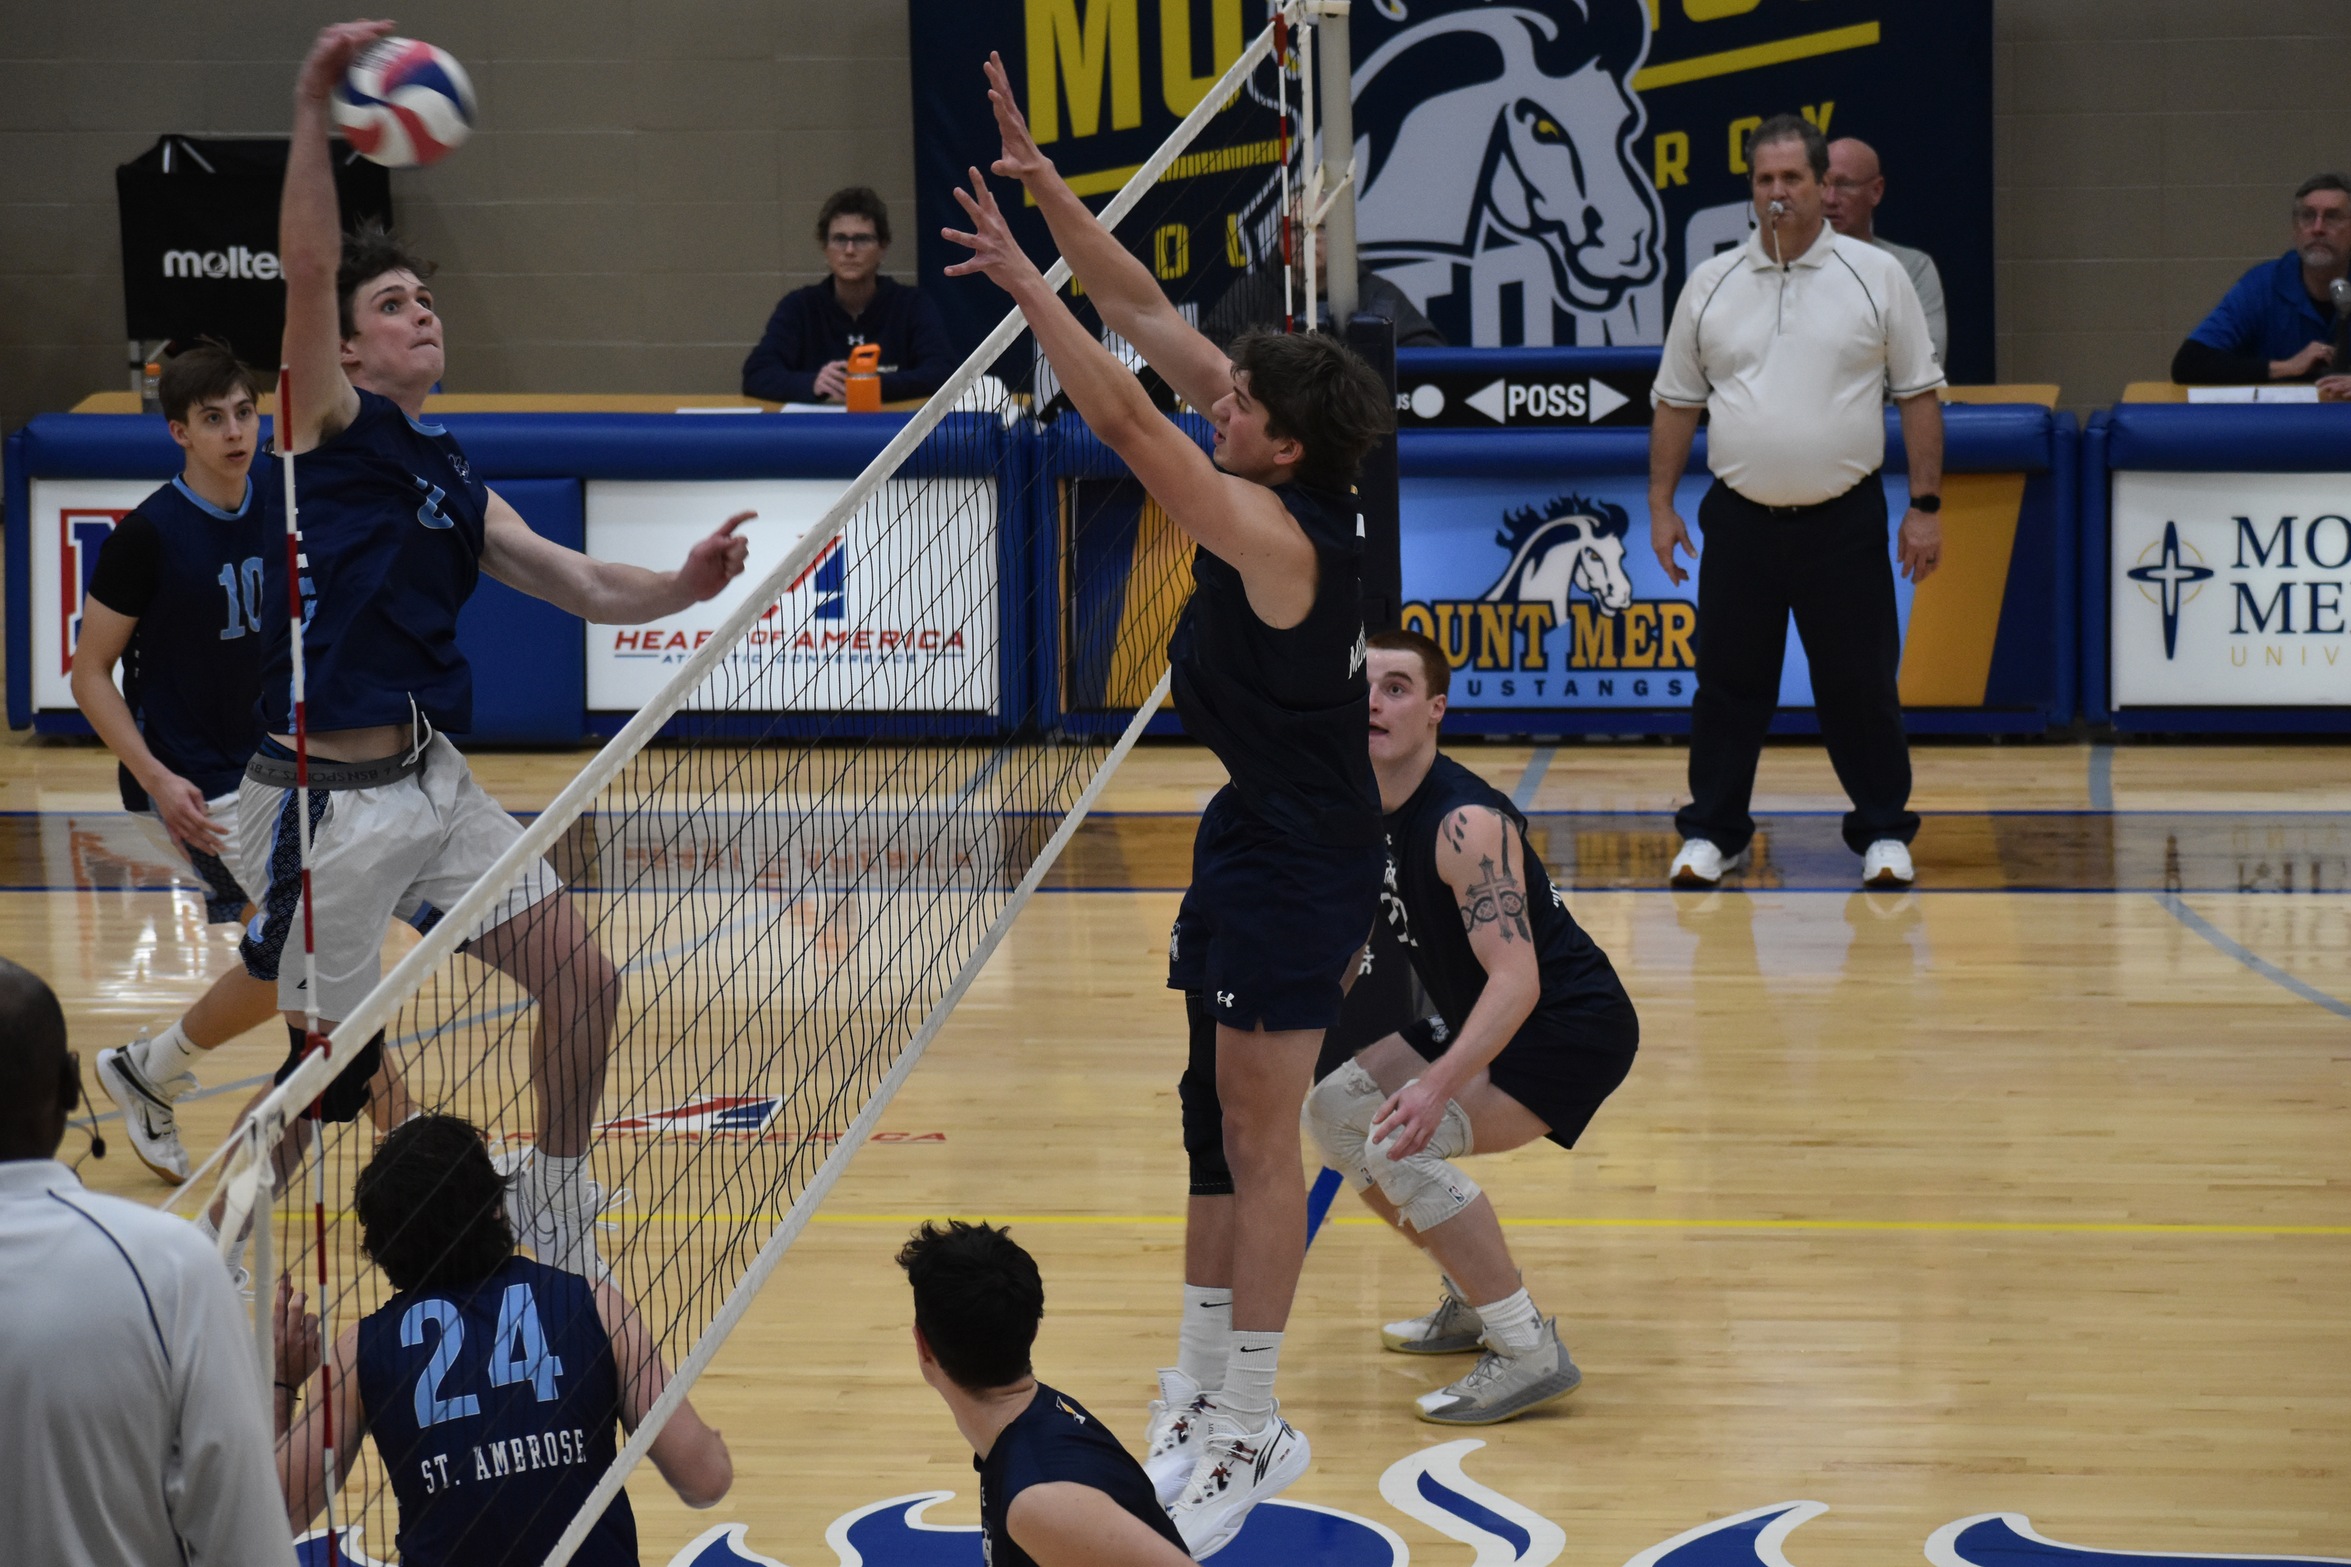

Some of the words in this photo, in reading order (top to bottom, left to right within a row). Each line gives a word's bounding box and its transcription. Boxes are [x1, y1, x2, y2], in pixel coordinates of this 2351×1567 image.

[163, 246, 285, 280] molte
[1507, 384, 1587, 417] POSS
[217, 556, 265, 641] 10
[751, 631, 787, 645] OF
[791, 631, 966, 650] AMERICA
[663, 1131, 947, 1142] AMERCA
[400, 1283, 564, 1429] 24
[421, 1454, 461, 1494] ST.
[473, 1429, 587, 1481] AMBROSE
